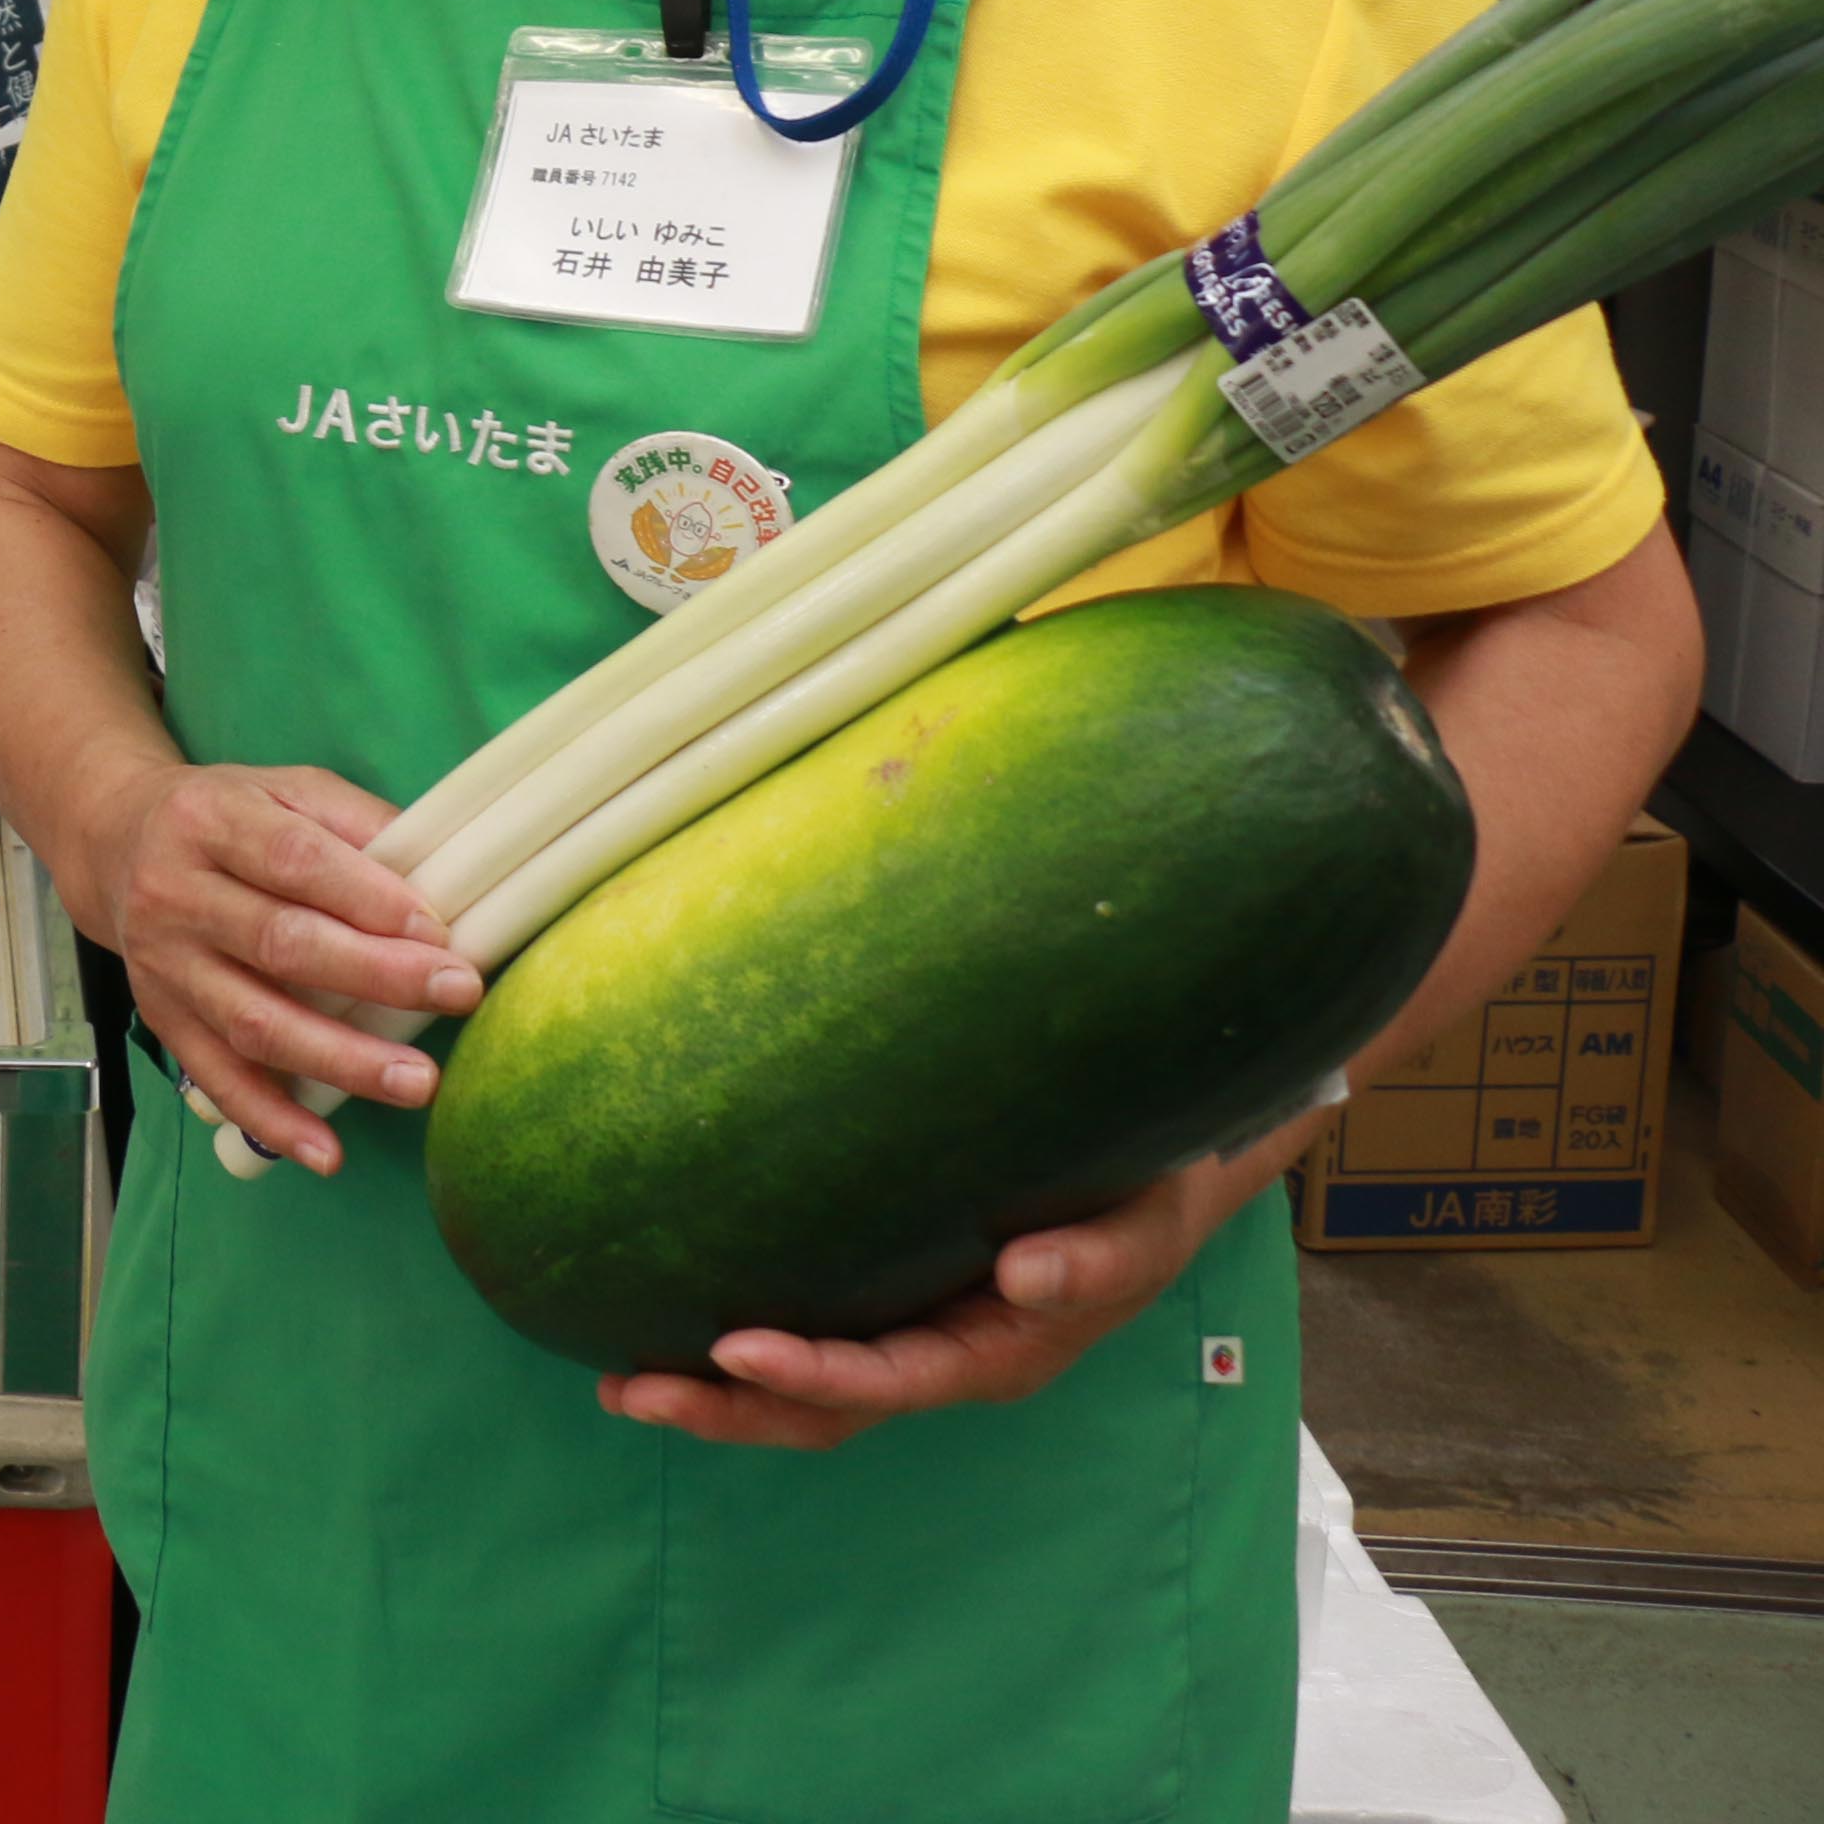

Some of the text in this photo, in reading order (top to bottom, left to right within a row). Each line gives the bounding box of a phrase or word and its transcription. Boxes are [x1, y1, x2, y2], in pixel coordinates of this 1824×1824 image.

[600, 170, 637, 188] 7142
[570, 217, 727, 247] いしい ゆみこ
[552, 250, 730, 289] 石井 由美子
[276, 384, 575, 476] JAさいたま
[1493, 1033, 1634, 1056] ハウス AM
